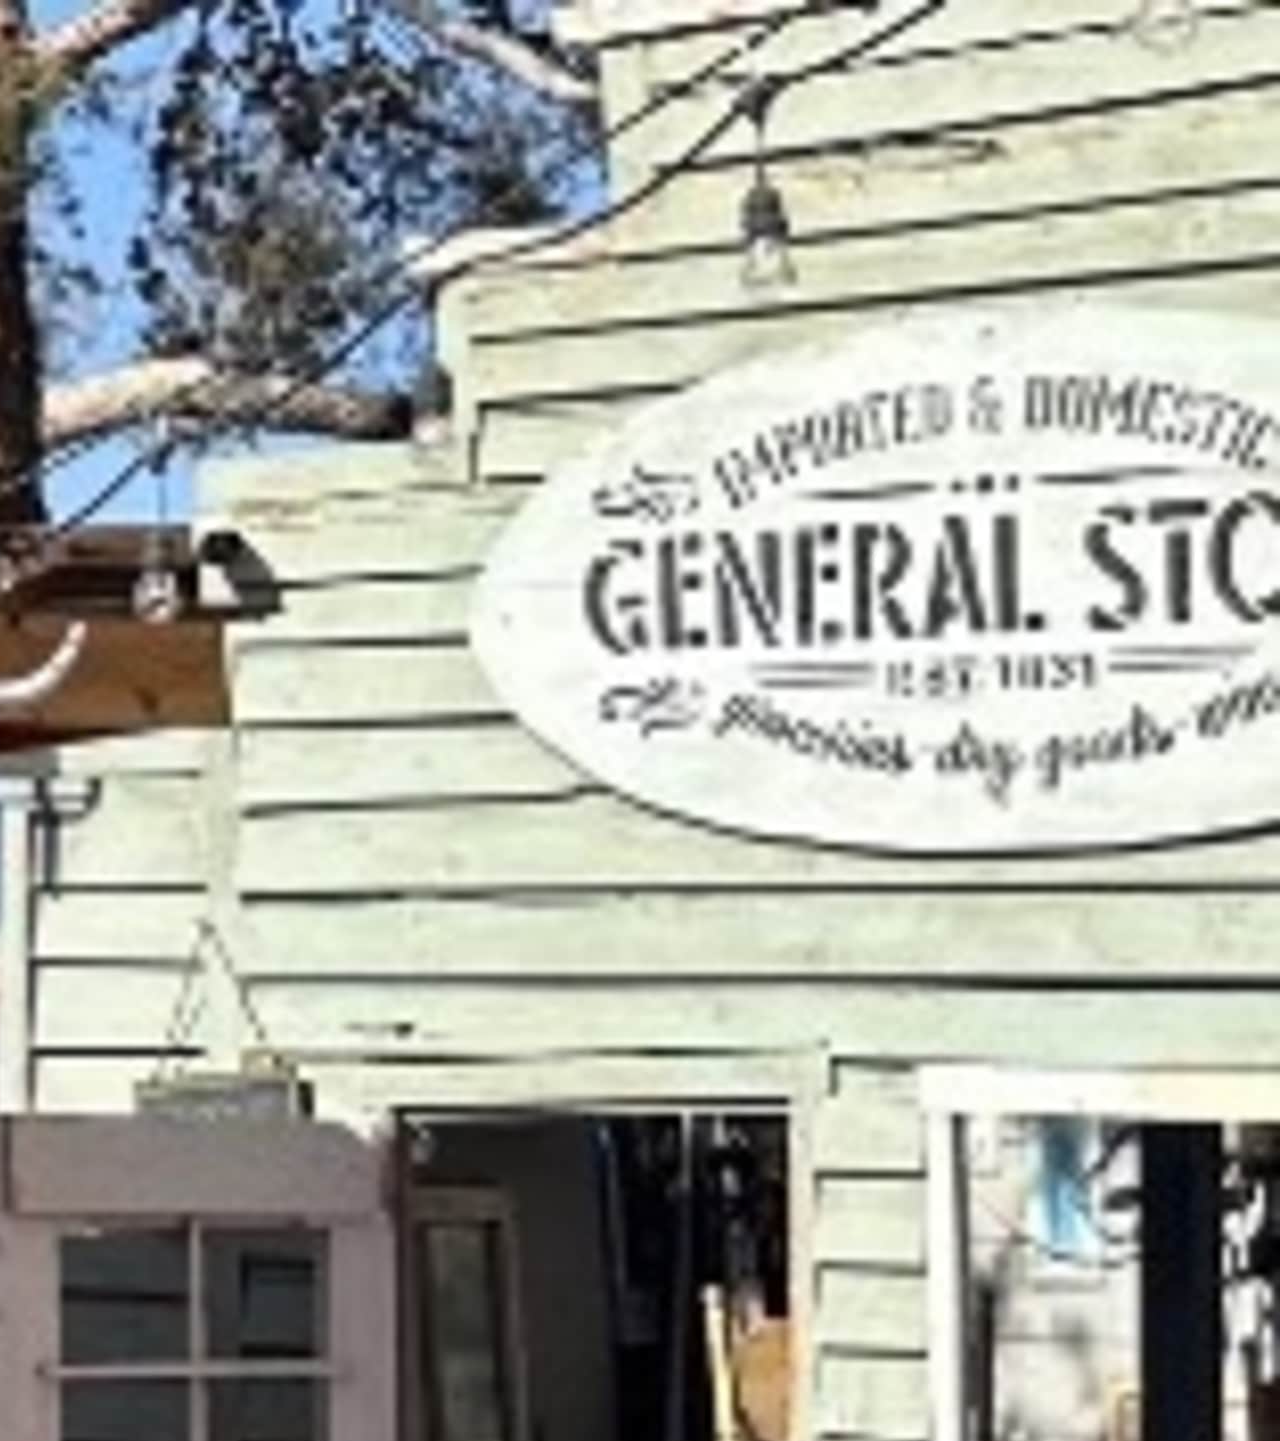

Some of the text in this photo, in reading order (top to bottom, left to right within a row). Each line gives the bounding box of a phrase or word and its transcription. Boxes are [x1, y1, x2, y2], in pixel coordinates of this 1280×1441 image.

[712, 380, 954, 510] IMPORTED
[968, 370, 1004, 434] &
[583, 490, 1280, 656] GENERAL STO
